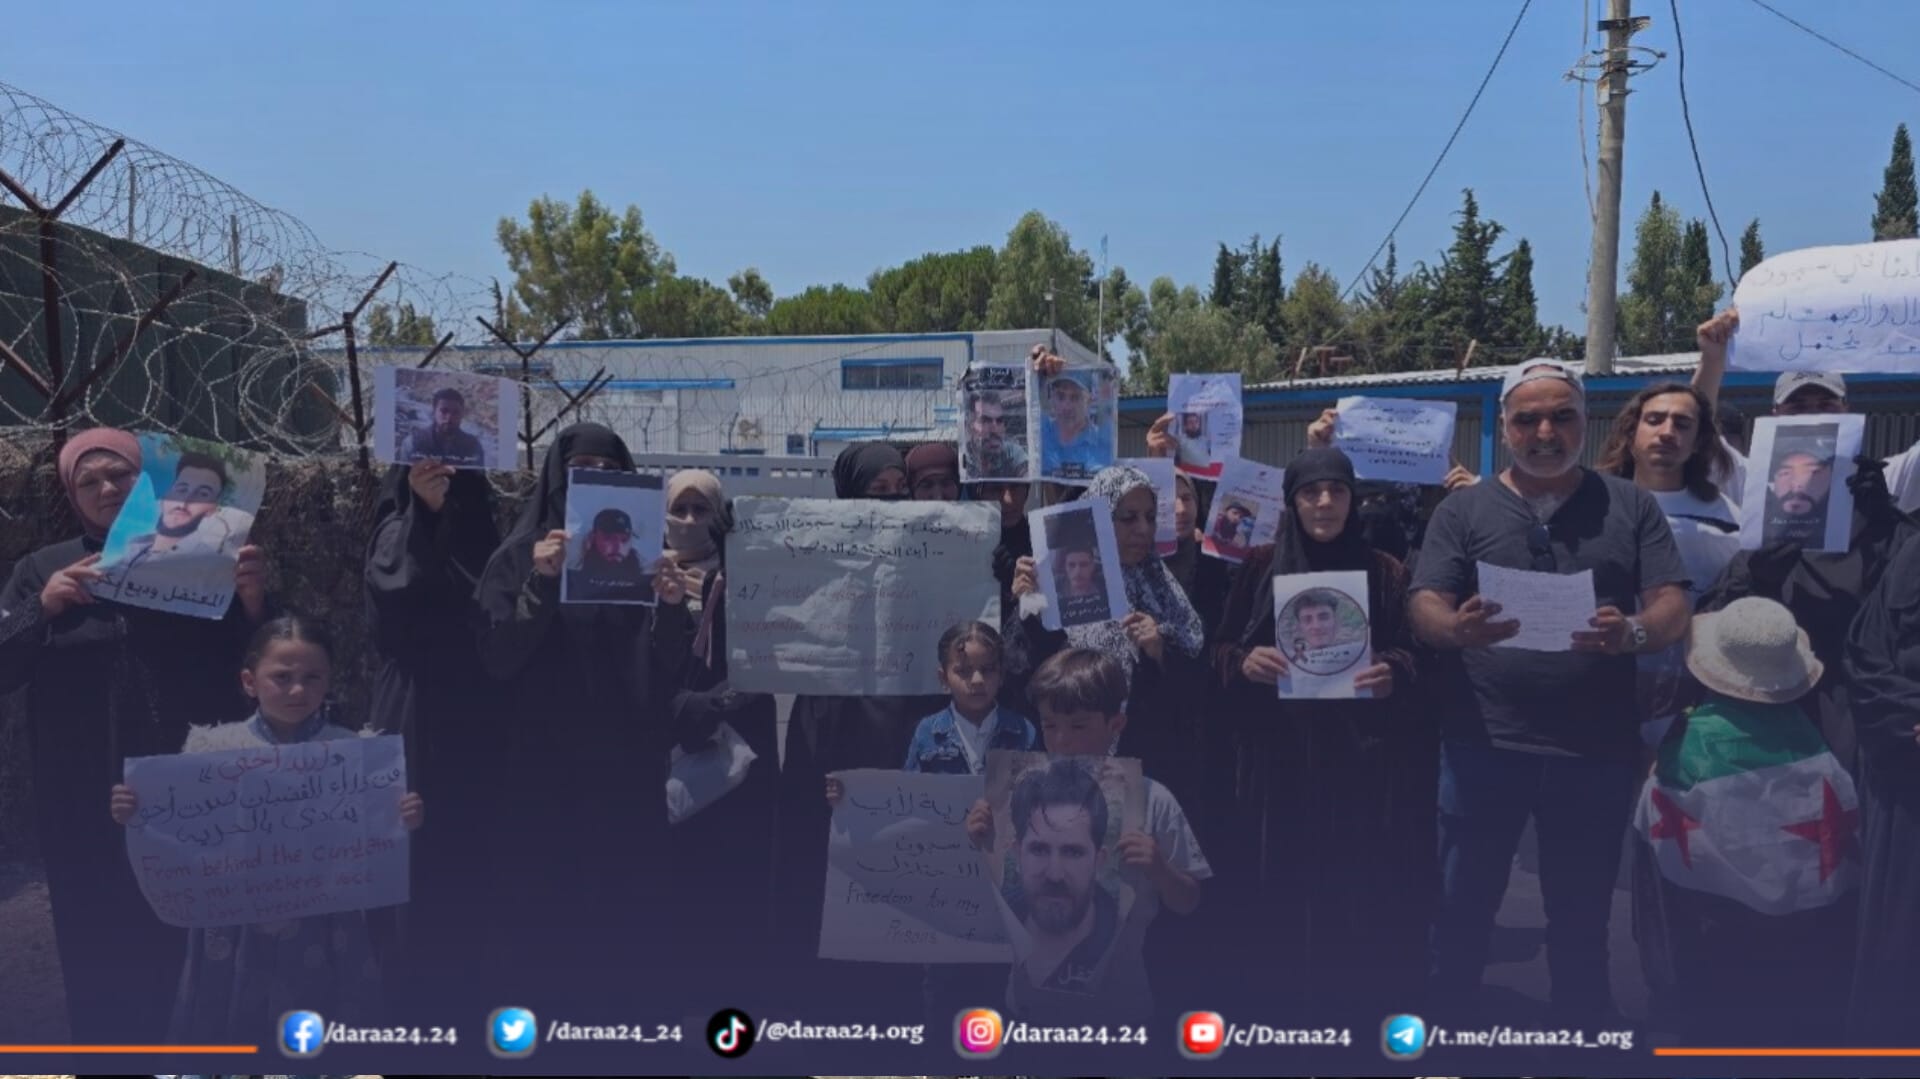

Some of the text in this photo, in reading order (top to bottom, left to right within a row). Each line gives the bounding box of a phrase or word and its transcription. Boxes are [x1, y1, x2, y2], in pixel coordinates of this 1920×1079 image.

[162, 586, 224, 607] المعتقل
[737, 583, 761, 600] 47
[142, 855, 192, 880] From
[202, 844, 263, 880] behind
[273, 844, 304, 864] the
[846, 882, 912, 905] Freedom
